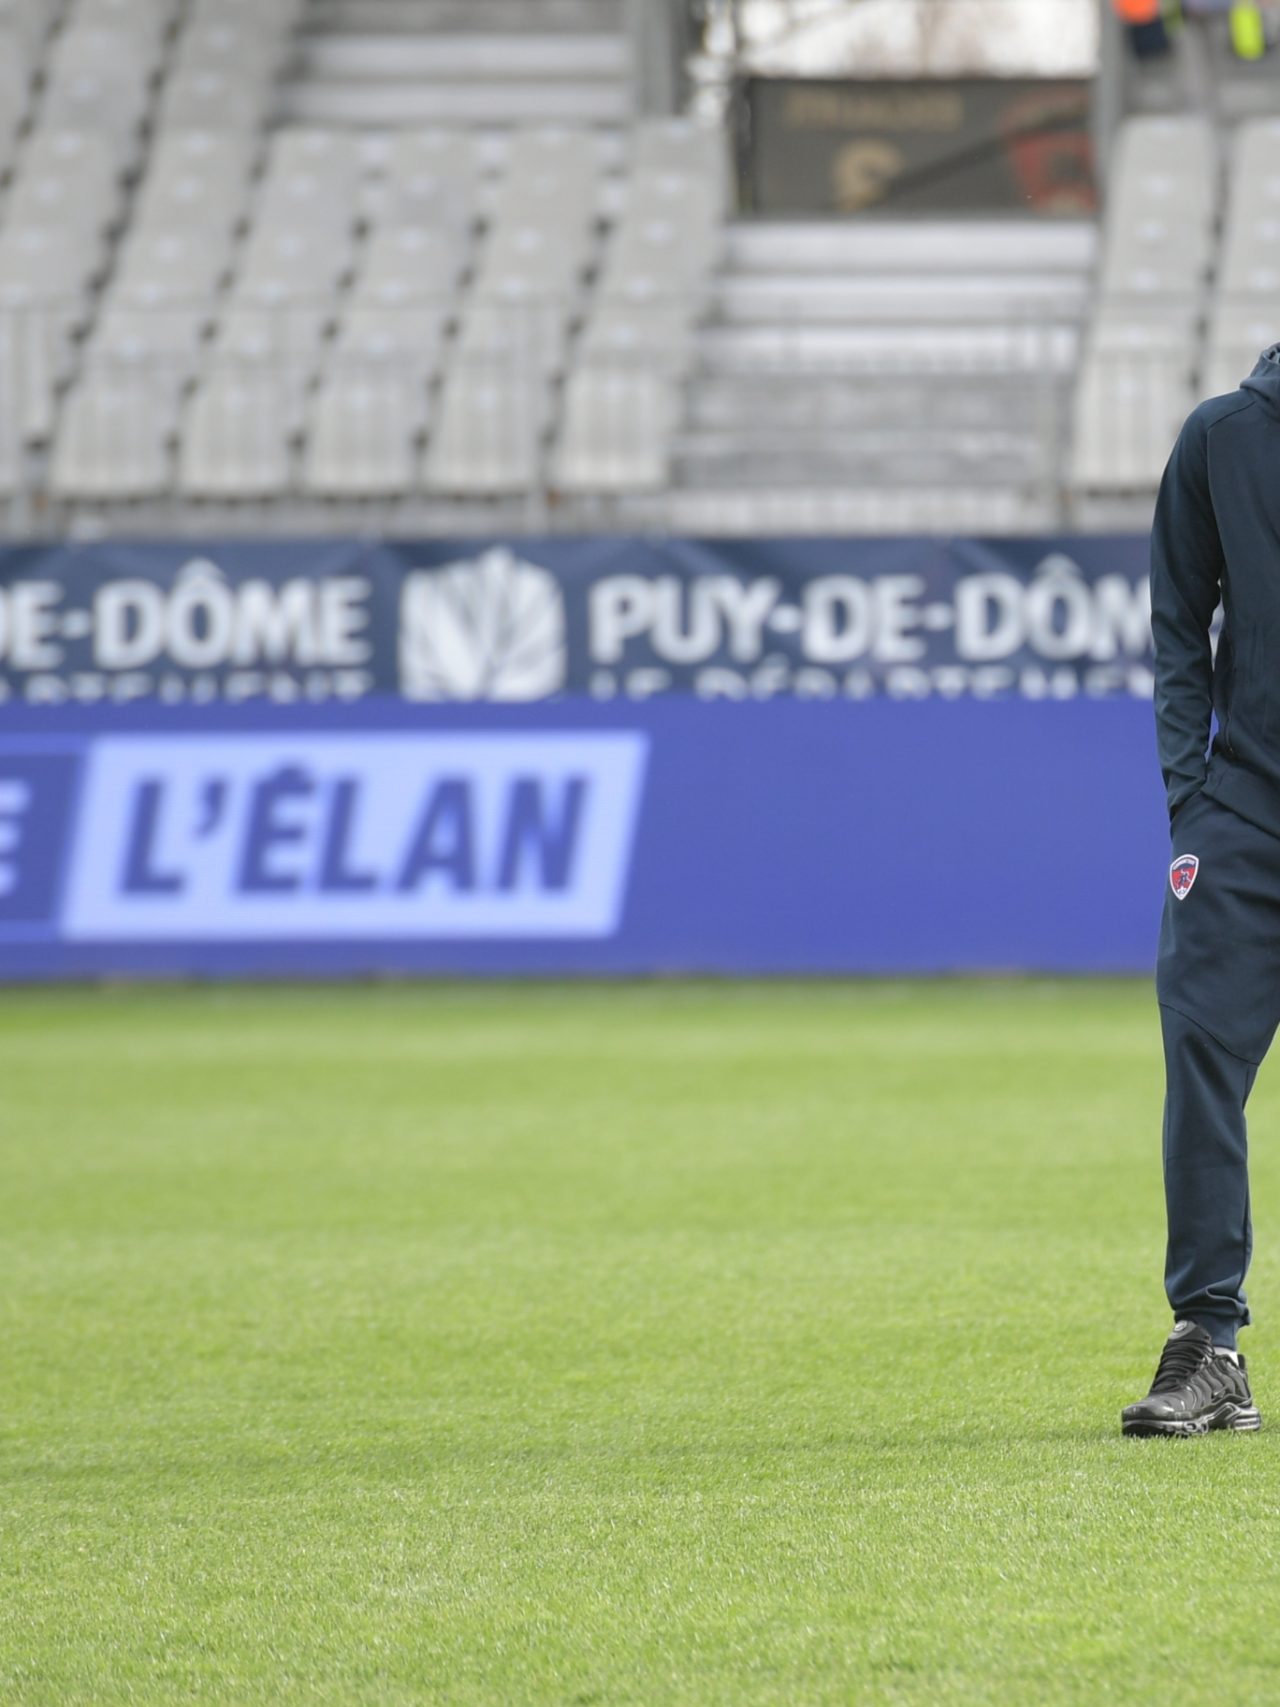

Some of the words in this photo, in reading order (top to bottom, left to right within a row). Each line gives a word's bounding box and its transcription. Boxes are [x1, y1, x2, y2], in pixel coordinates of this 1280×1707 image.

[0, 556, 374, 669] E-DÔME
[589, 553, 1156, 665] PUY-DE-DÔM
[118, 753, 590, 894] L'ÉLAN
